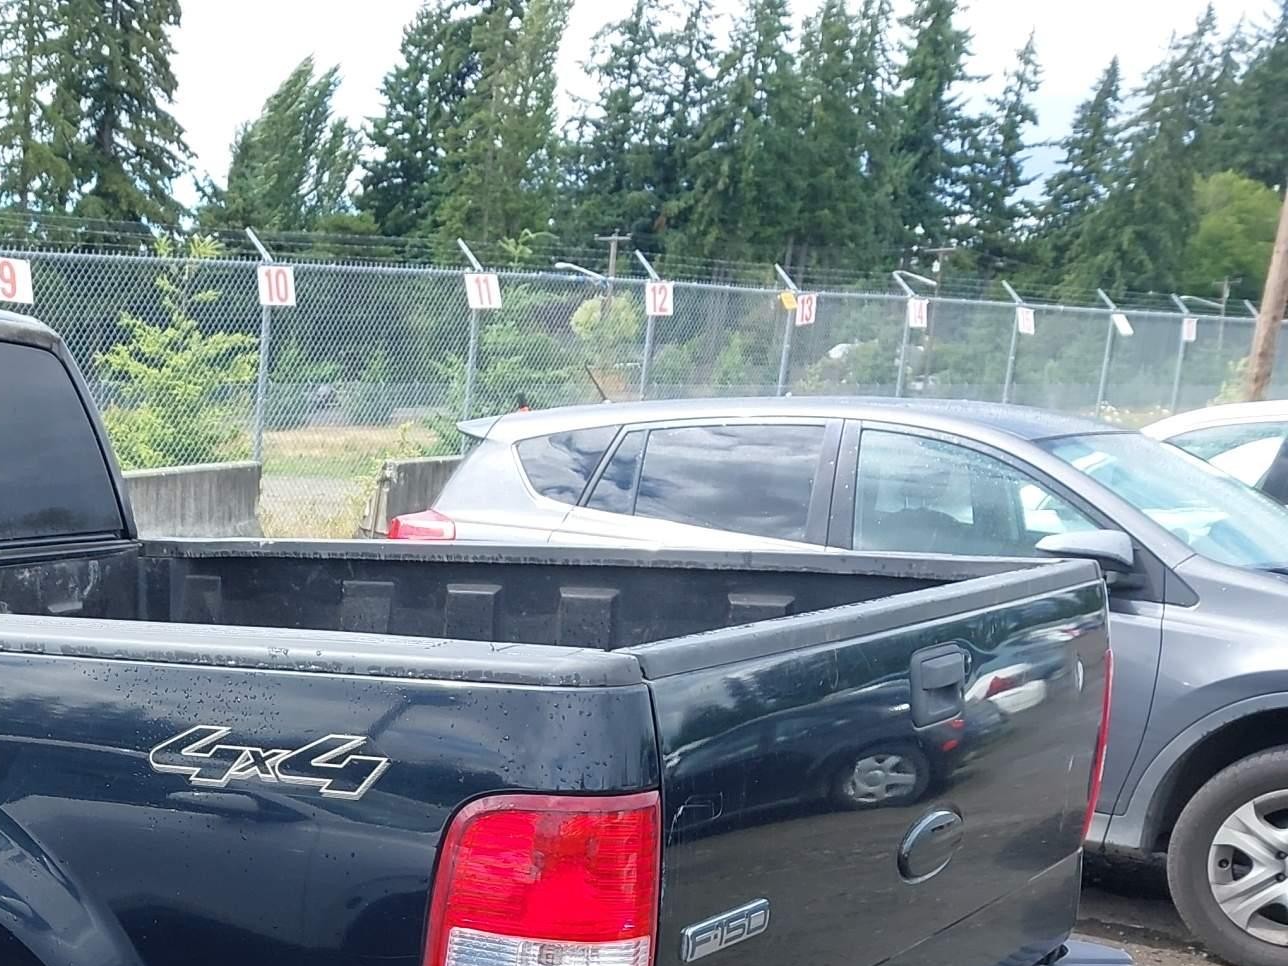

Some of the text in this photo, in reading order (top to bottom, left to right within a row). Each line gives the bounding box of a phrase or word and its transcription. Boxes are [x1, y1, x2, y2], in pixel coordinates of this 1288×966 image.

[264, 269, 289, 303] 10
[475, 275, 493, 306] 11
[650, 284, 668, 313] 12
[800, 296, 813, 322] 13
[149, 724, 393, 801] 4x4
